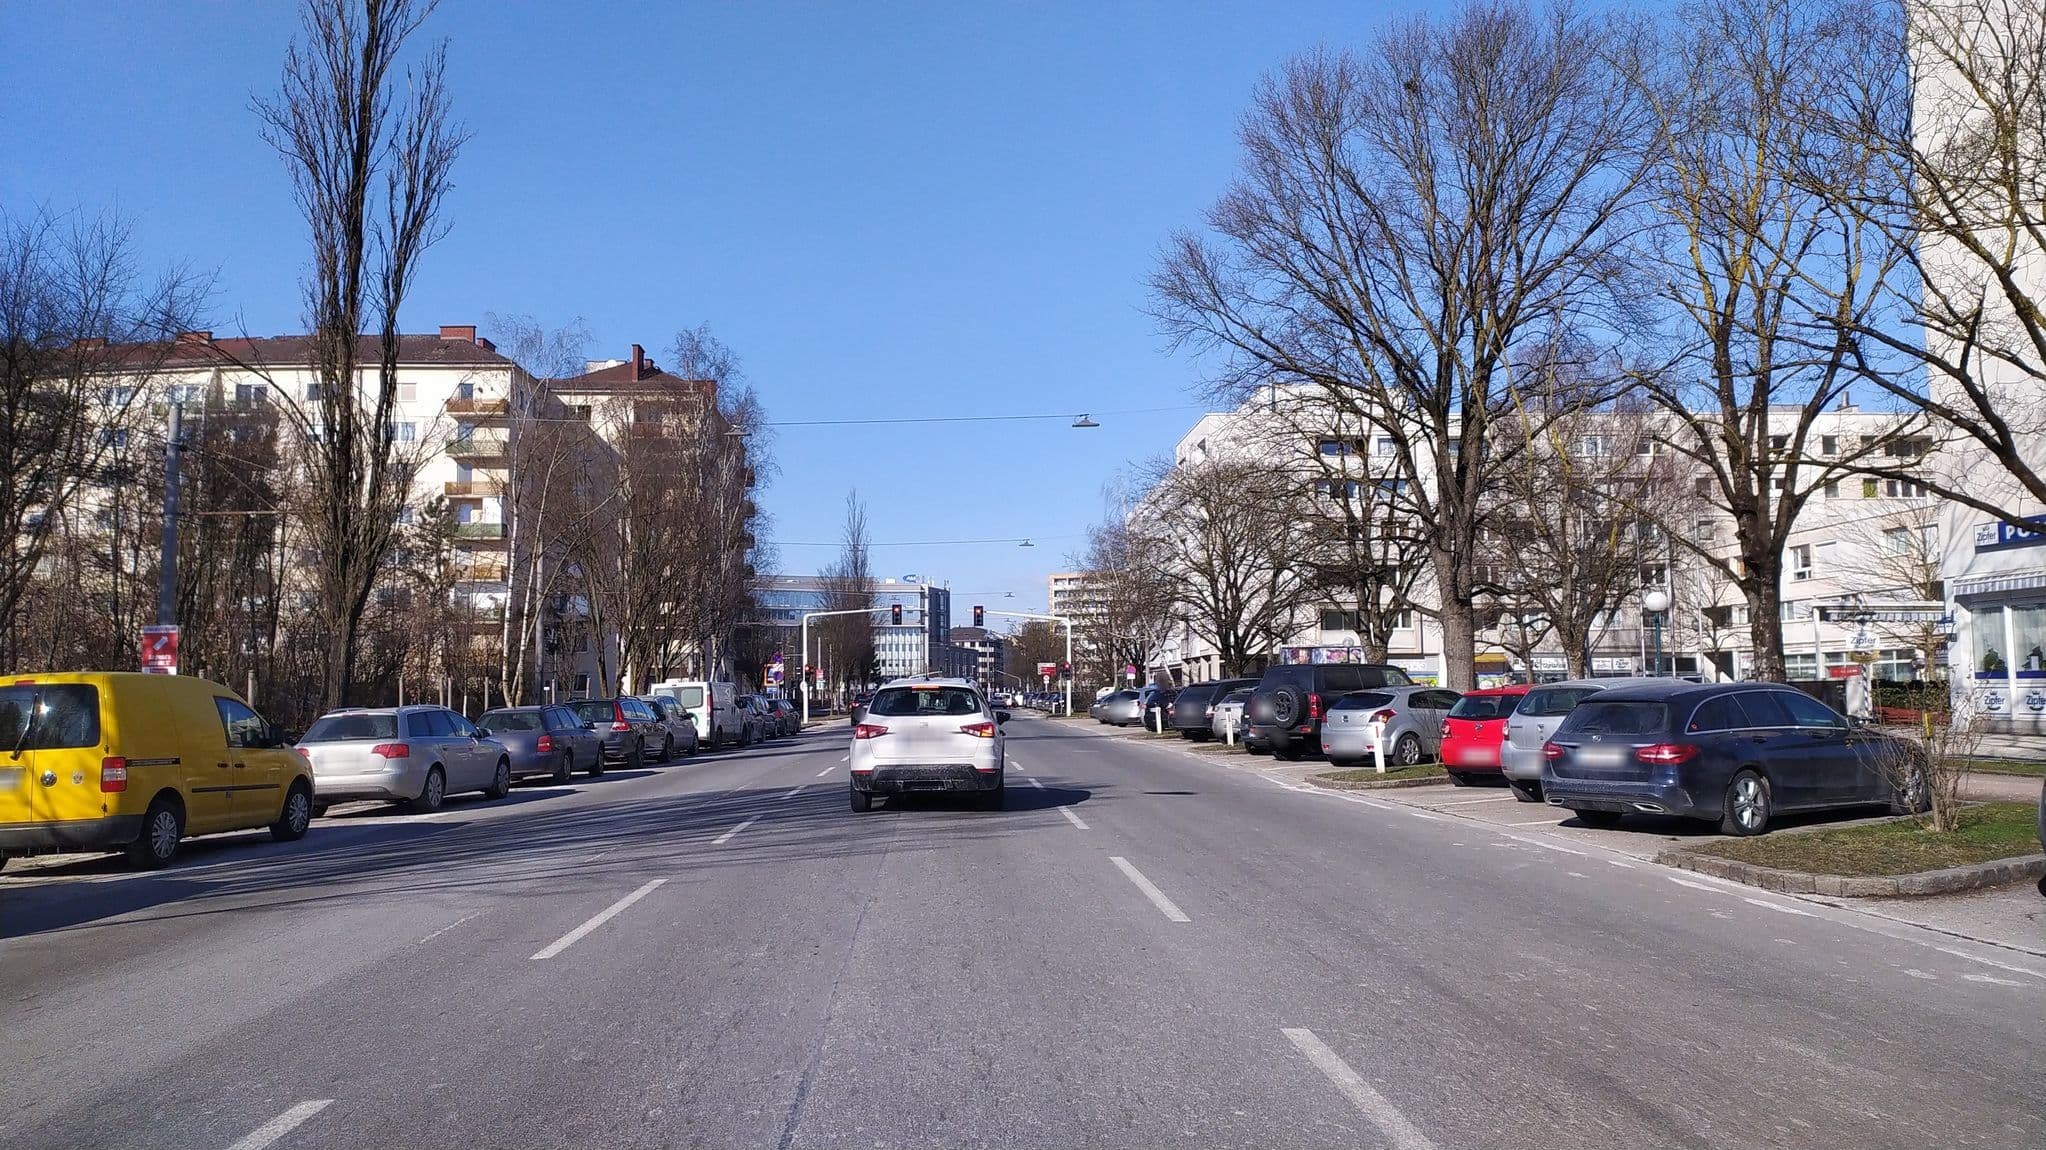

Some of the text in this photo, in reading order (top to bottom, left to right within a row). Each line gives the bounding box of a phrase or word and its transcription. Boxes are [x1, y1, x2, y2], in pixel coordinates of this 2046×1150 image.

[1851, 636, 1877, 645] Zipfer
[1984, 695, 2005, 707] Zipfer
[2026, 695, 2046, 707] Zipfe
